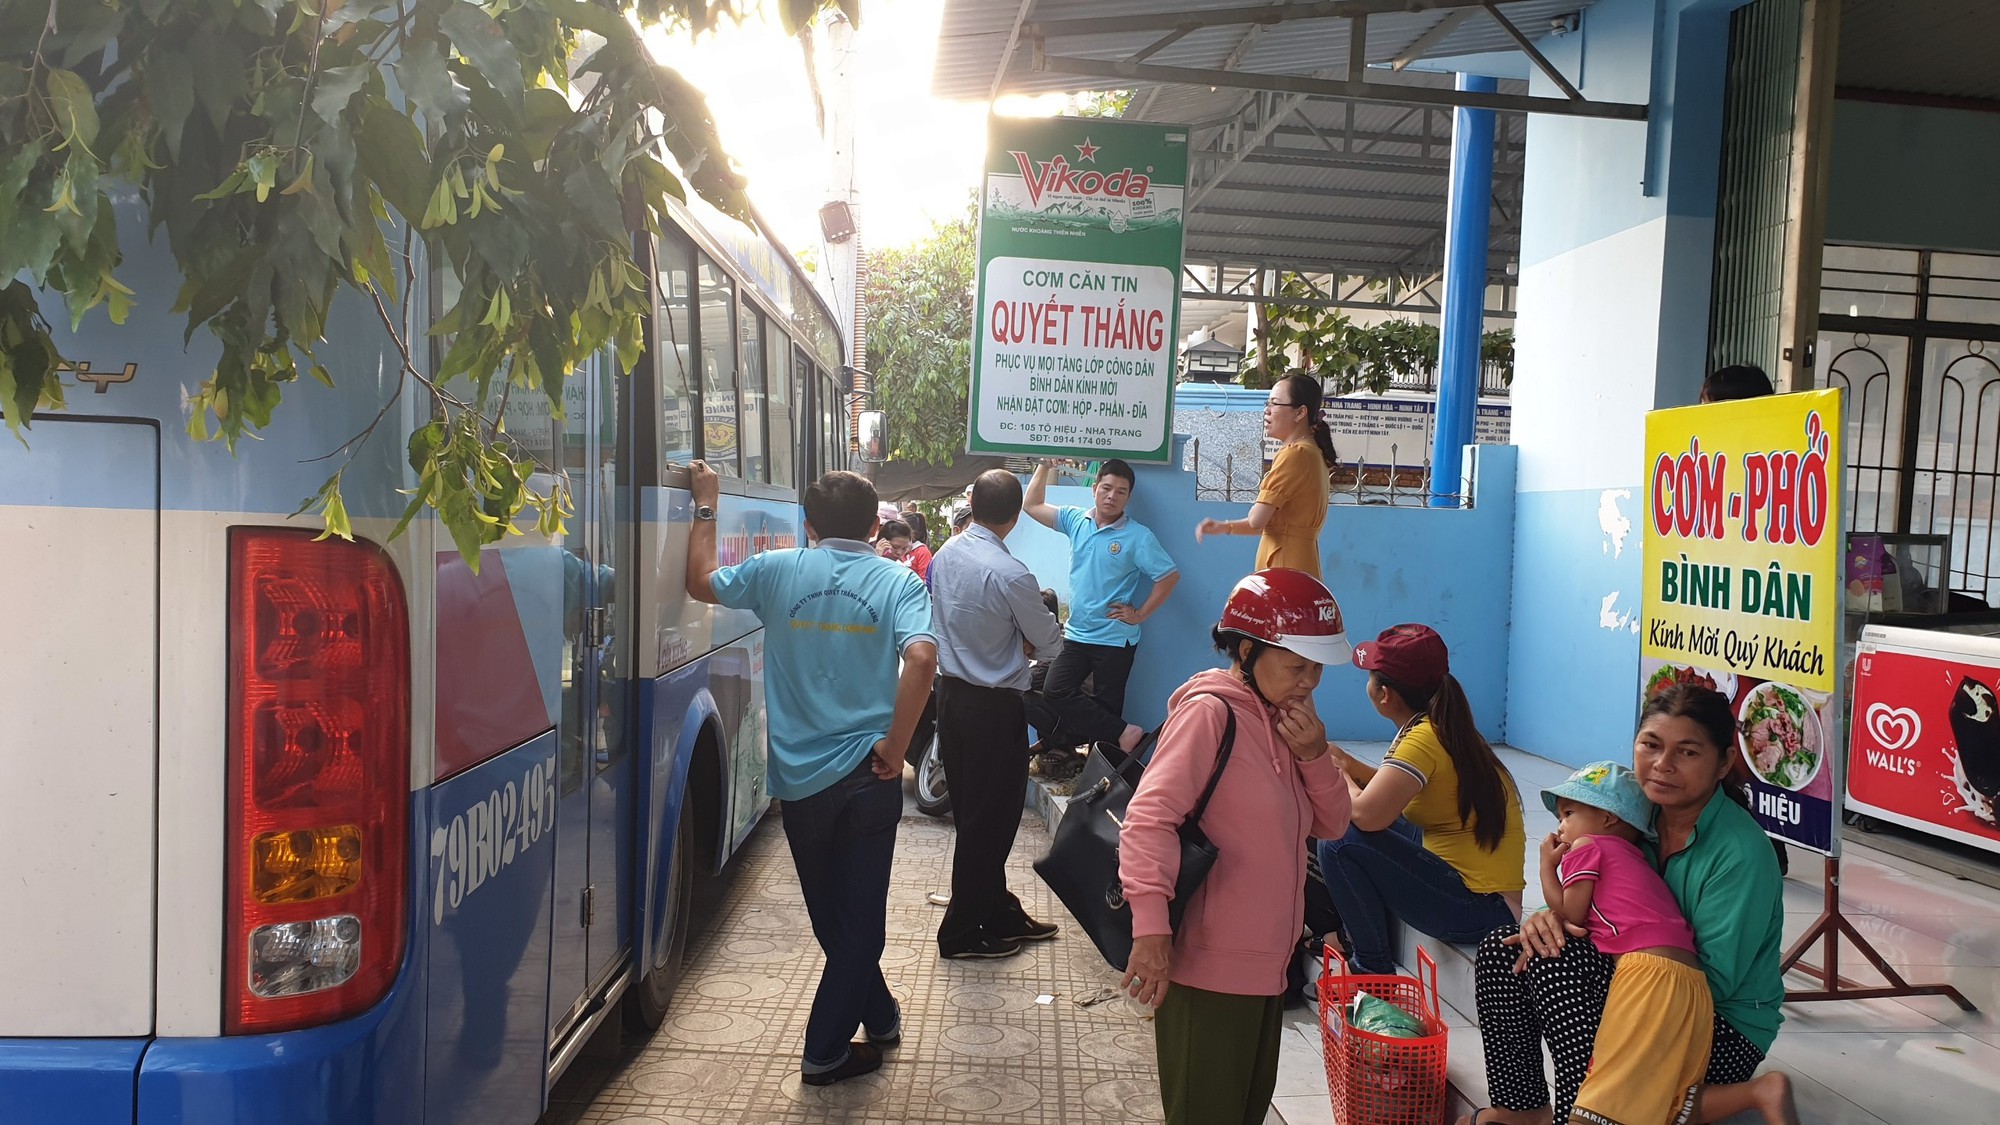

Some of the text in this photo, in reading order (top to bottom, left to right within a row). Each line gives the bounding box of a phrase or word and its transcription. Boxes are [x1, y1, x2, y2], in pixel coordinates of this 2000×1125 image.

[1007, 150, 1149, 208] Vikoda
[1132, 198, 1152, 206] 100%
[1022, 270, 1138, 292] CƠM CĂN TIN
[991, 294, 1164, 352] QUYẾT THẮNG
[996, 354, 1020, 372] PHỤC
[1023, 355, 1036, 374] VỤ
[1038, 356, 1054, 374] MỌI
[1085, 355, 1104, 374] LỚP
[1106, 356, 1133, 376] CÔNG
[1135, 358, 1155, 377] DÂN
[1030, 373, 1118, 396] BÌNH DÂN KÍNH MỜI
[997, 394, 1023, 415] NHẬN
[1046, 399, 1070, 414] CƠM:
[1072, 398, 1092, 419] HỘP
[1132, 402, 1148, 418] ĐĨA
[1344, 402, 1362, 410] TRANG
[1000, 422, 1017, 430] ĐC:
[1020, 423, 1036, 432] 105
[1054, 425, 1077, 435] HIỆU
[1086, 426, 1106, 436] NHA
[1108, 428, 1142, 438] TRANG
[1030, 434, 1112, 446] SĐT: 0914 174 095
[1661, 554, 1812, 621] BÌNH DÂN
[790, 604, 801, 618] CÔNG
[807, 590, 822, 600] TNHH
[824, 588, 840, 596] QUYẾT
[841, 588, 858, 600] THẮNG
[866, 605, 878, 623] TRANG
[1649, 618, 1824, 676] Kính Mời Quý Khách
[1866, 749, 1916, 776] WALL'S
[1759, 792, 1800, 826] HIỆU
[430, 753, 556, 926] 79B02495
